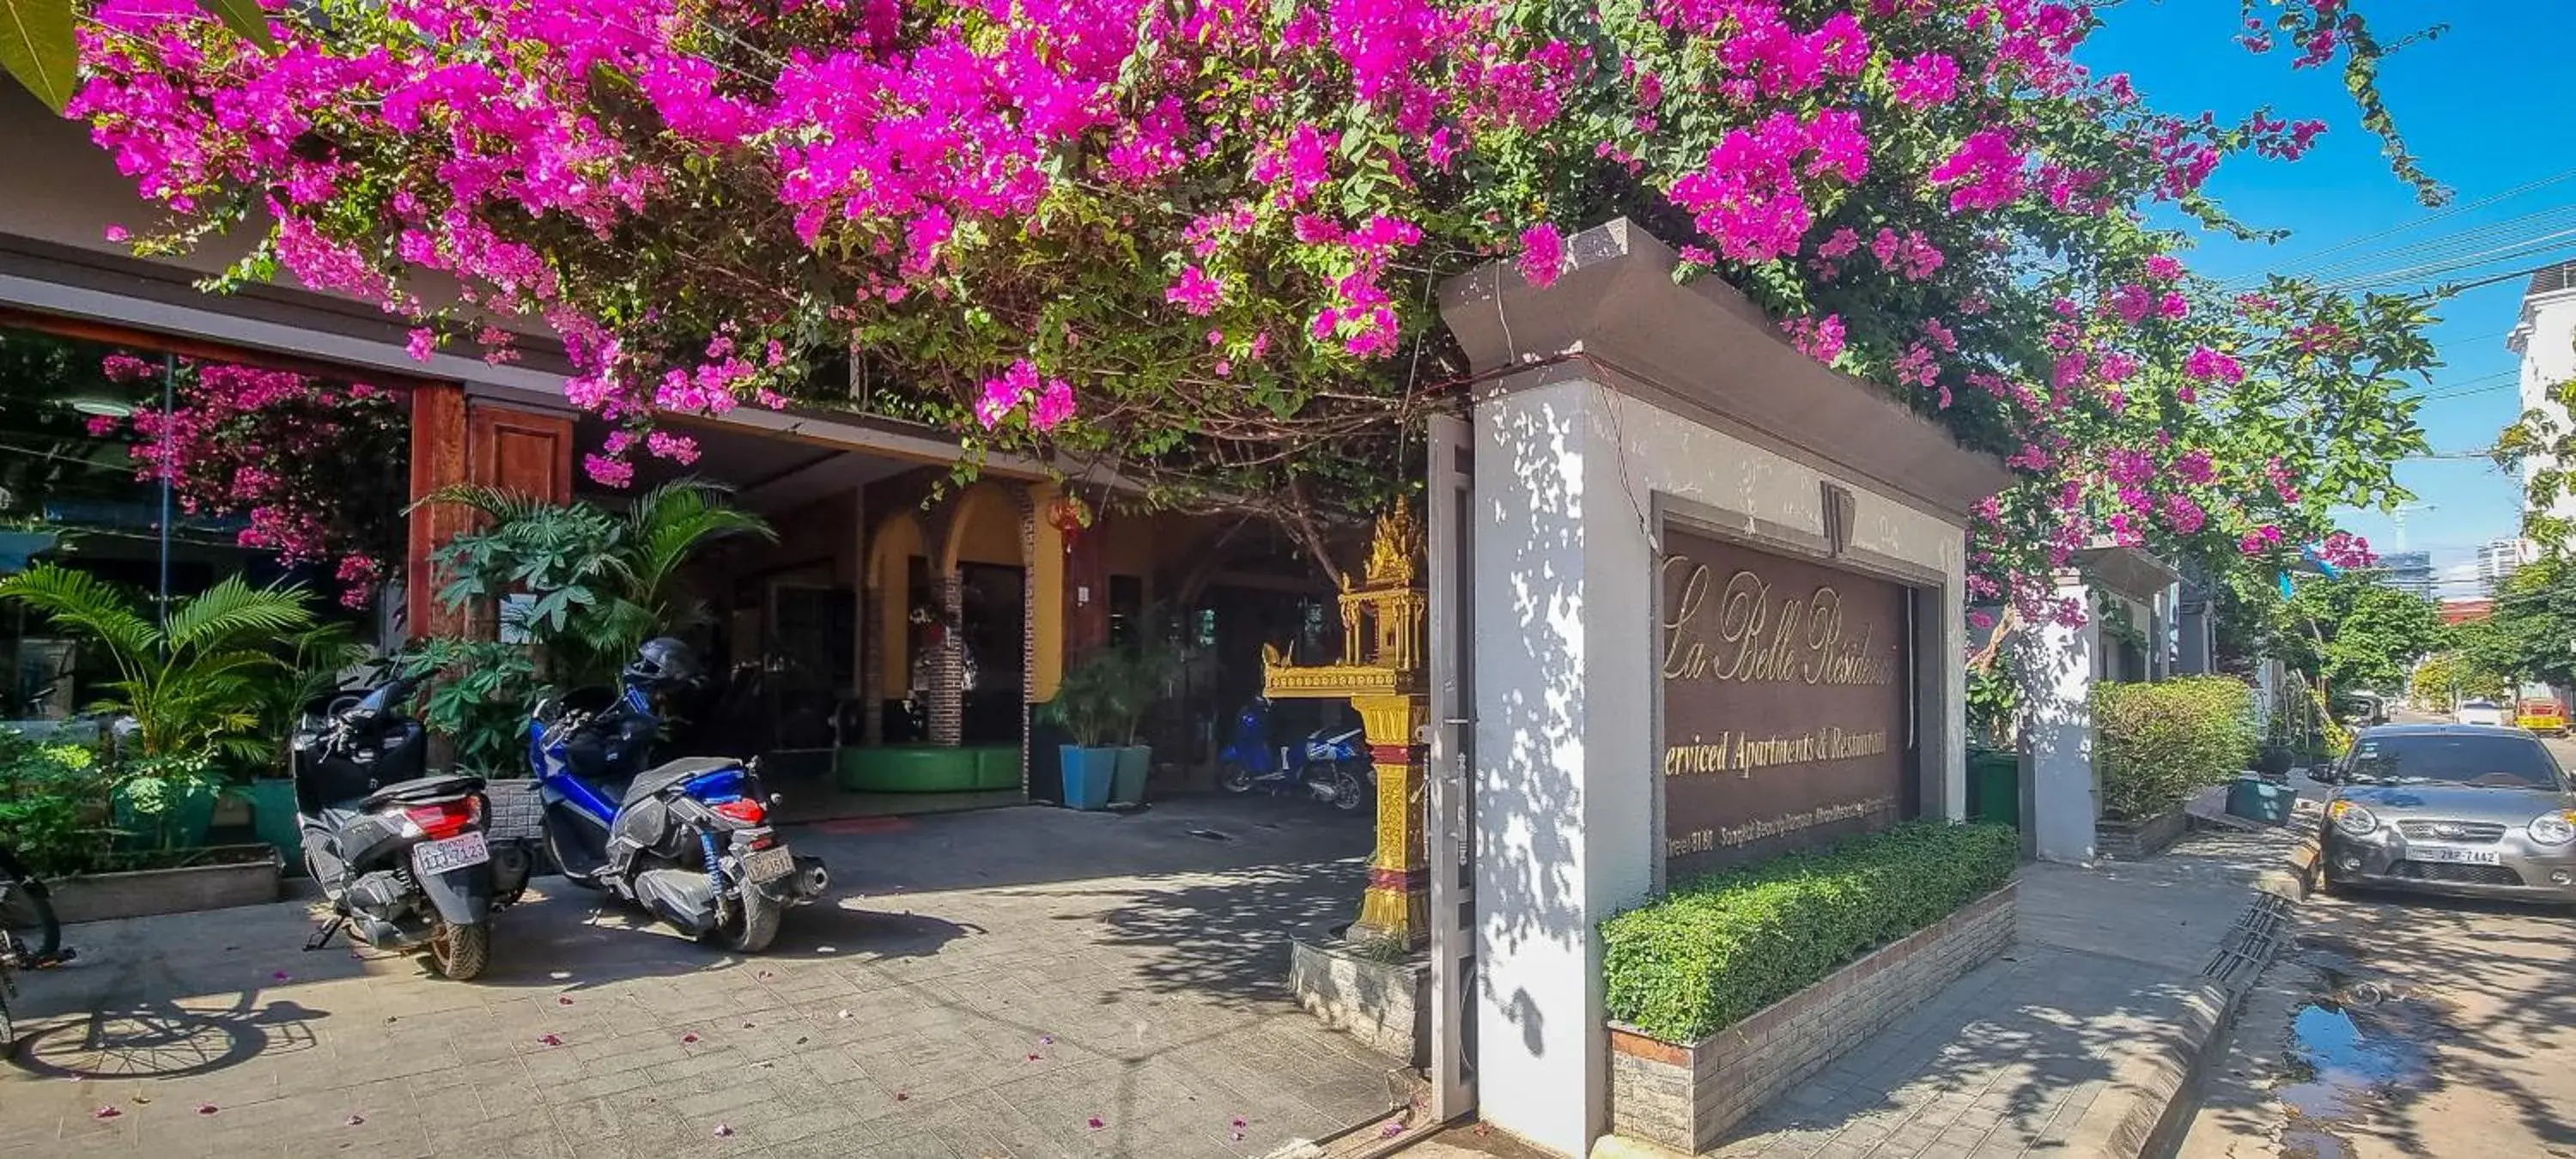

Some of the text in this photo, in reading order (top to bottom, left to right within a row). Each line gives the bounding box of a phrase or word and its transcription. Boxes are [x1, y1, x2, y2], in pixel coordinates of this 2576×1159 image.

[1662, 555, 1710, 679] La
[1713, 571, 1801, 682] Belle
[1665, 731, 1730, 776] erviced
[1732, 731, 1814, 779] Apartments
[1816, 728, 1828, 760] &
[1665, 835, 1690, 858] treet
